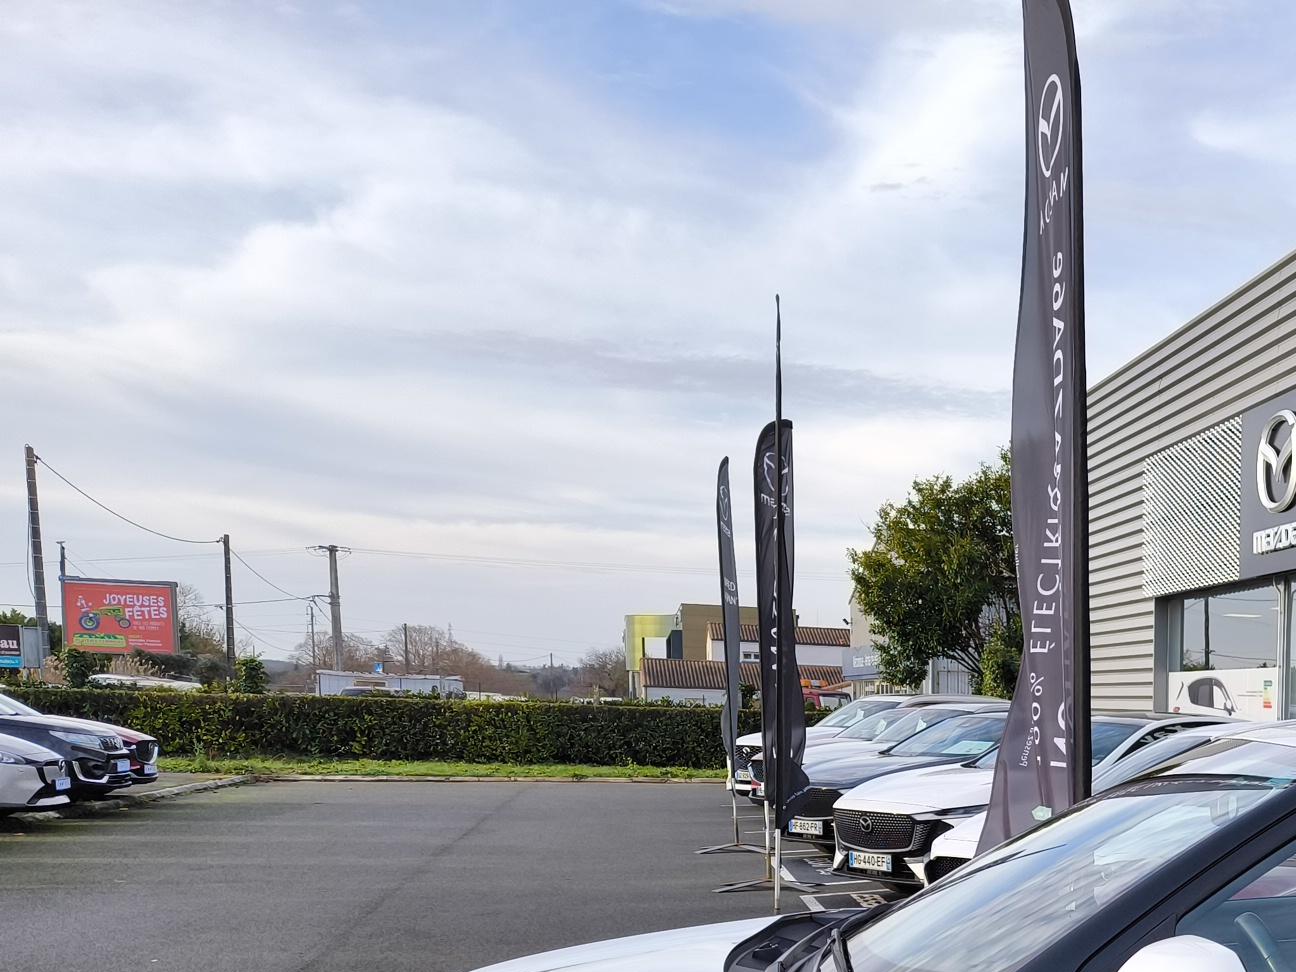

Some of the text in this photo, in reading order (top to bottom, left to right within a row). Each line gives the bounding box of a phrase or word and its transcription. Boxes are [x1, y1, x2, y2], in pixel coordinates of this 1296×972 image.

[103, 593, 165, 607] JOYEUSES
[124, 606, 168, 619] FÊTES
[0, 639, 18, 649] au
